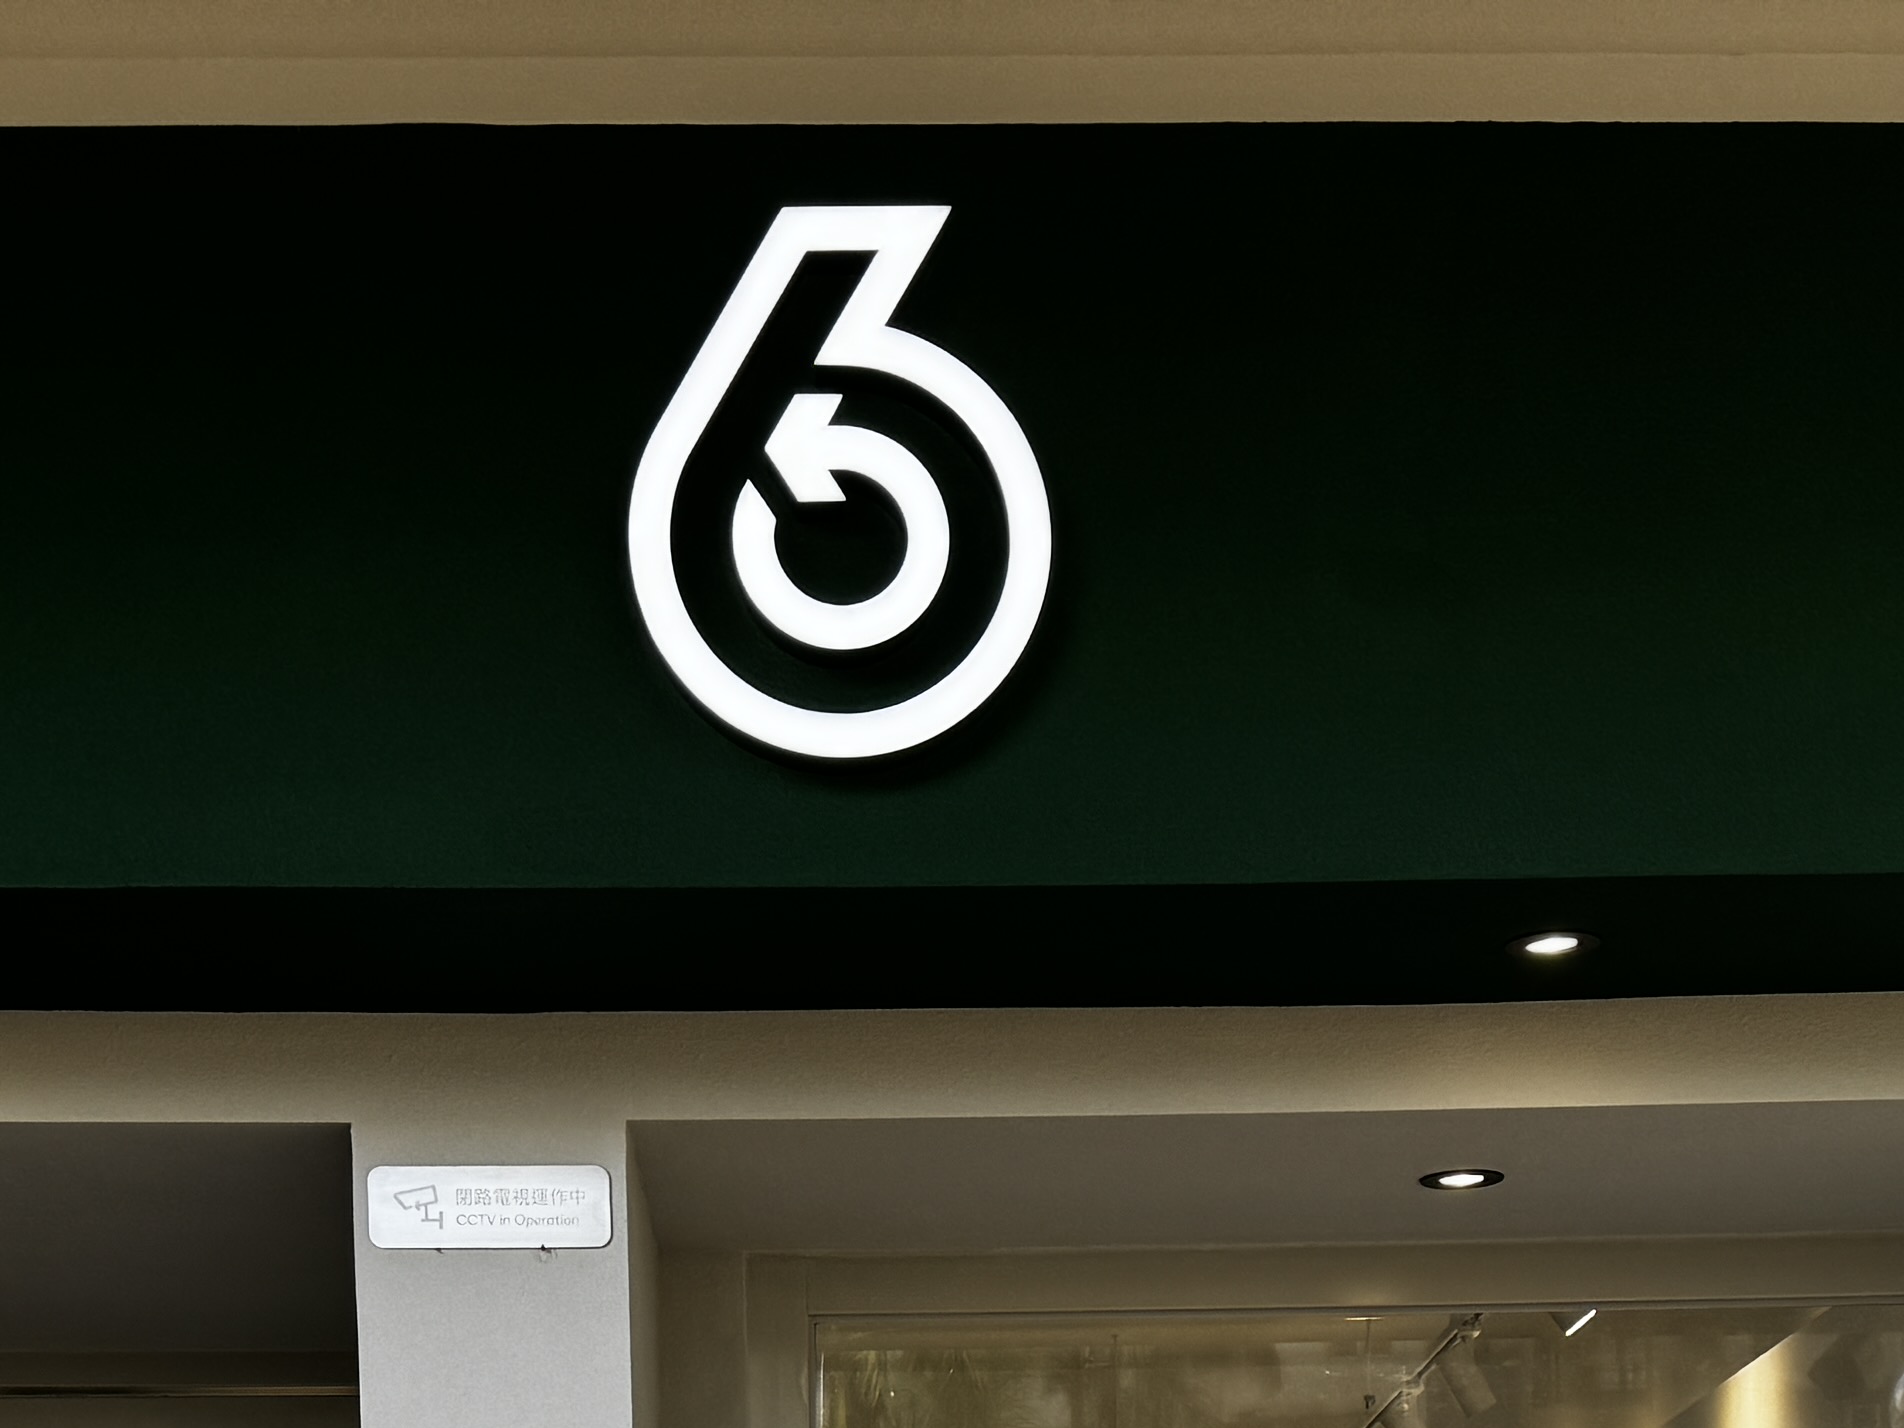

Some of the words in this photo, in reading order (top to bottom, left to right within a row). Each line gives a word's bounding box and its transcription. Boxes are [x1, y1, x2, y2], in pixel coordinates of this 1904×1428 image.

[628, 205, 1052, 758] 6
[456, 1188, 586, 1206] 閉路電視運作中
[456, 1214, 496, 1226] CCTV
[499, 1214, 511, 1226] in
[514, 1214, 580, 1228] Operation
